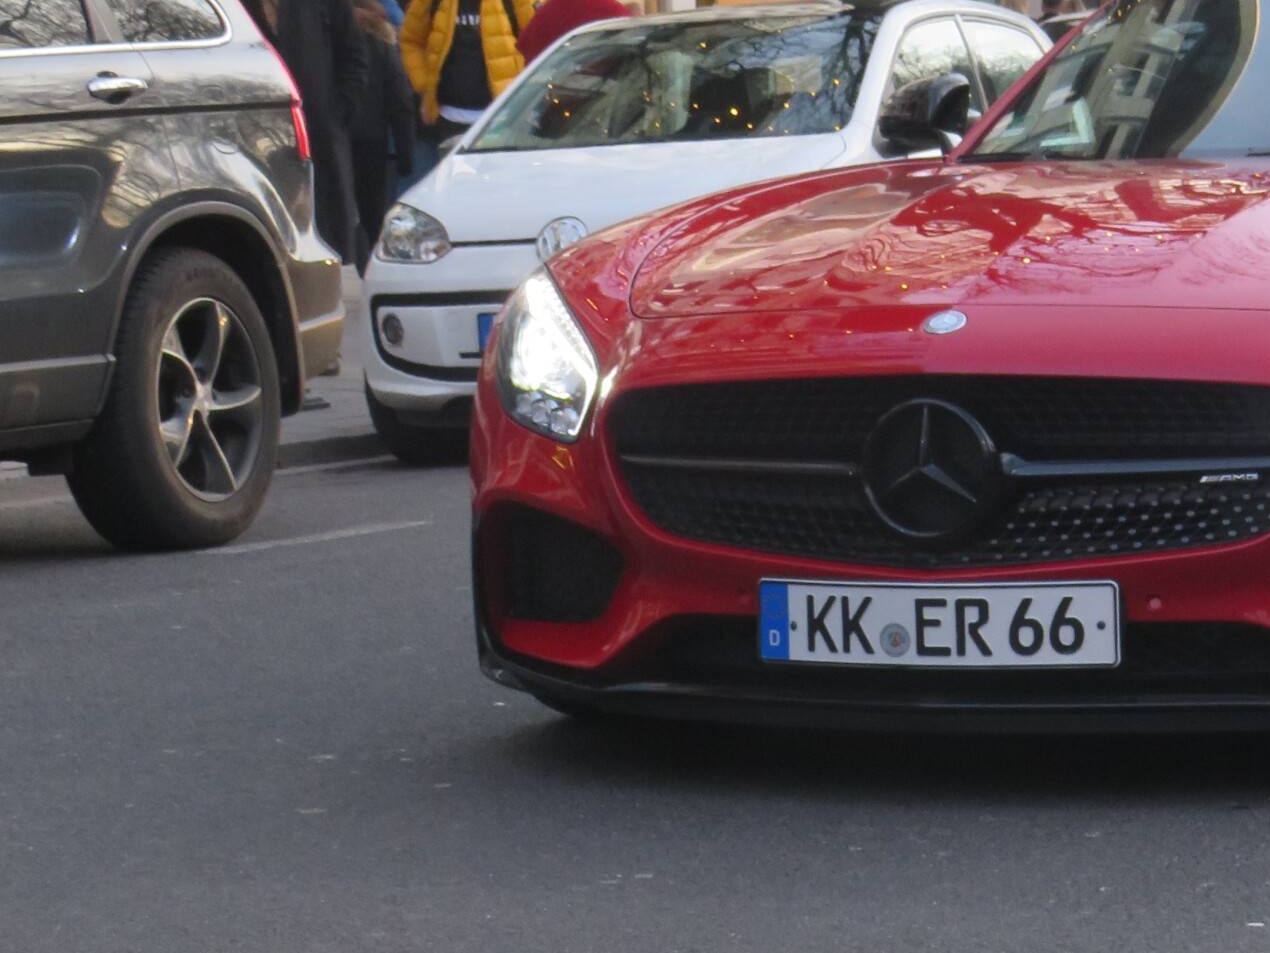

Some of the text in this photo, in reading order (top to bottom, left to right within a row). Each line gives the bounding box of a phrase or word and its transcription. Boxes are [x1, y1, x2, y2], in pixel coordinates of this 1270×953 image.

[768, 629, 780, 646] D
[806, 595, 1086, 657] KK ER 66
